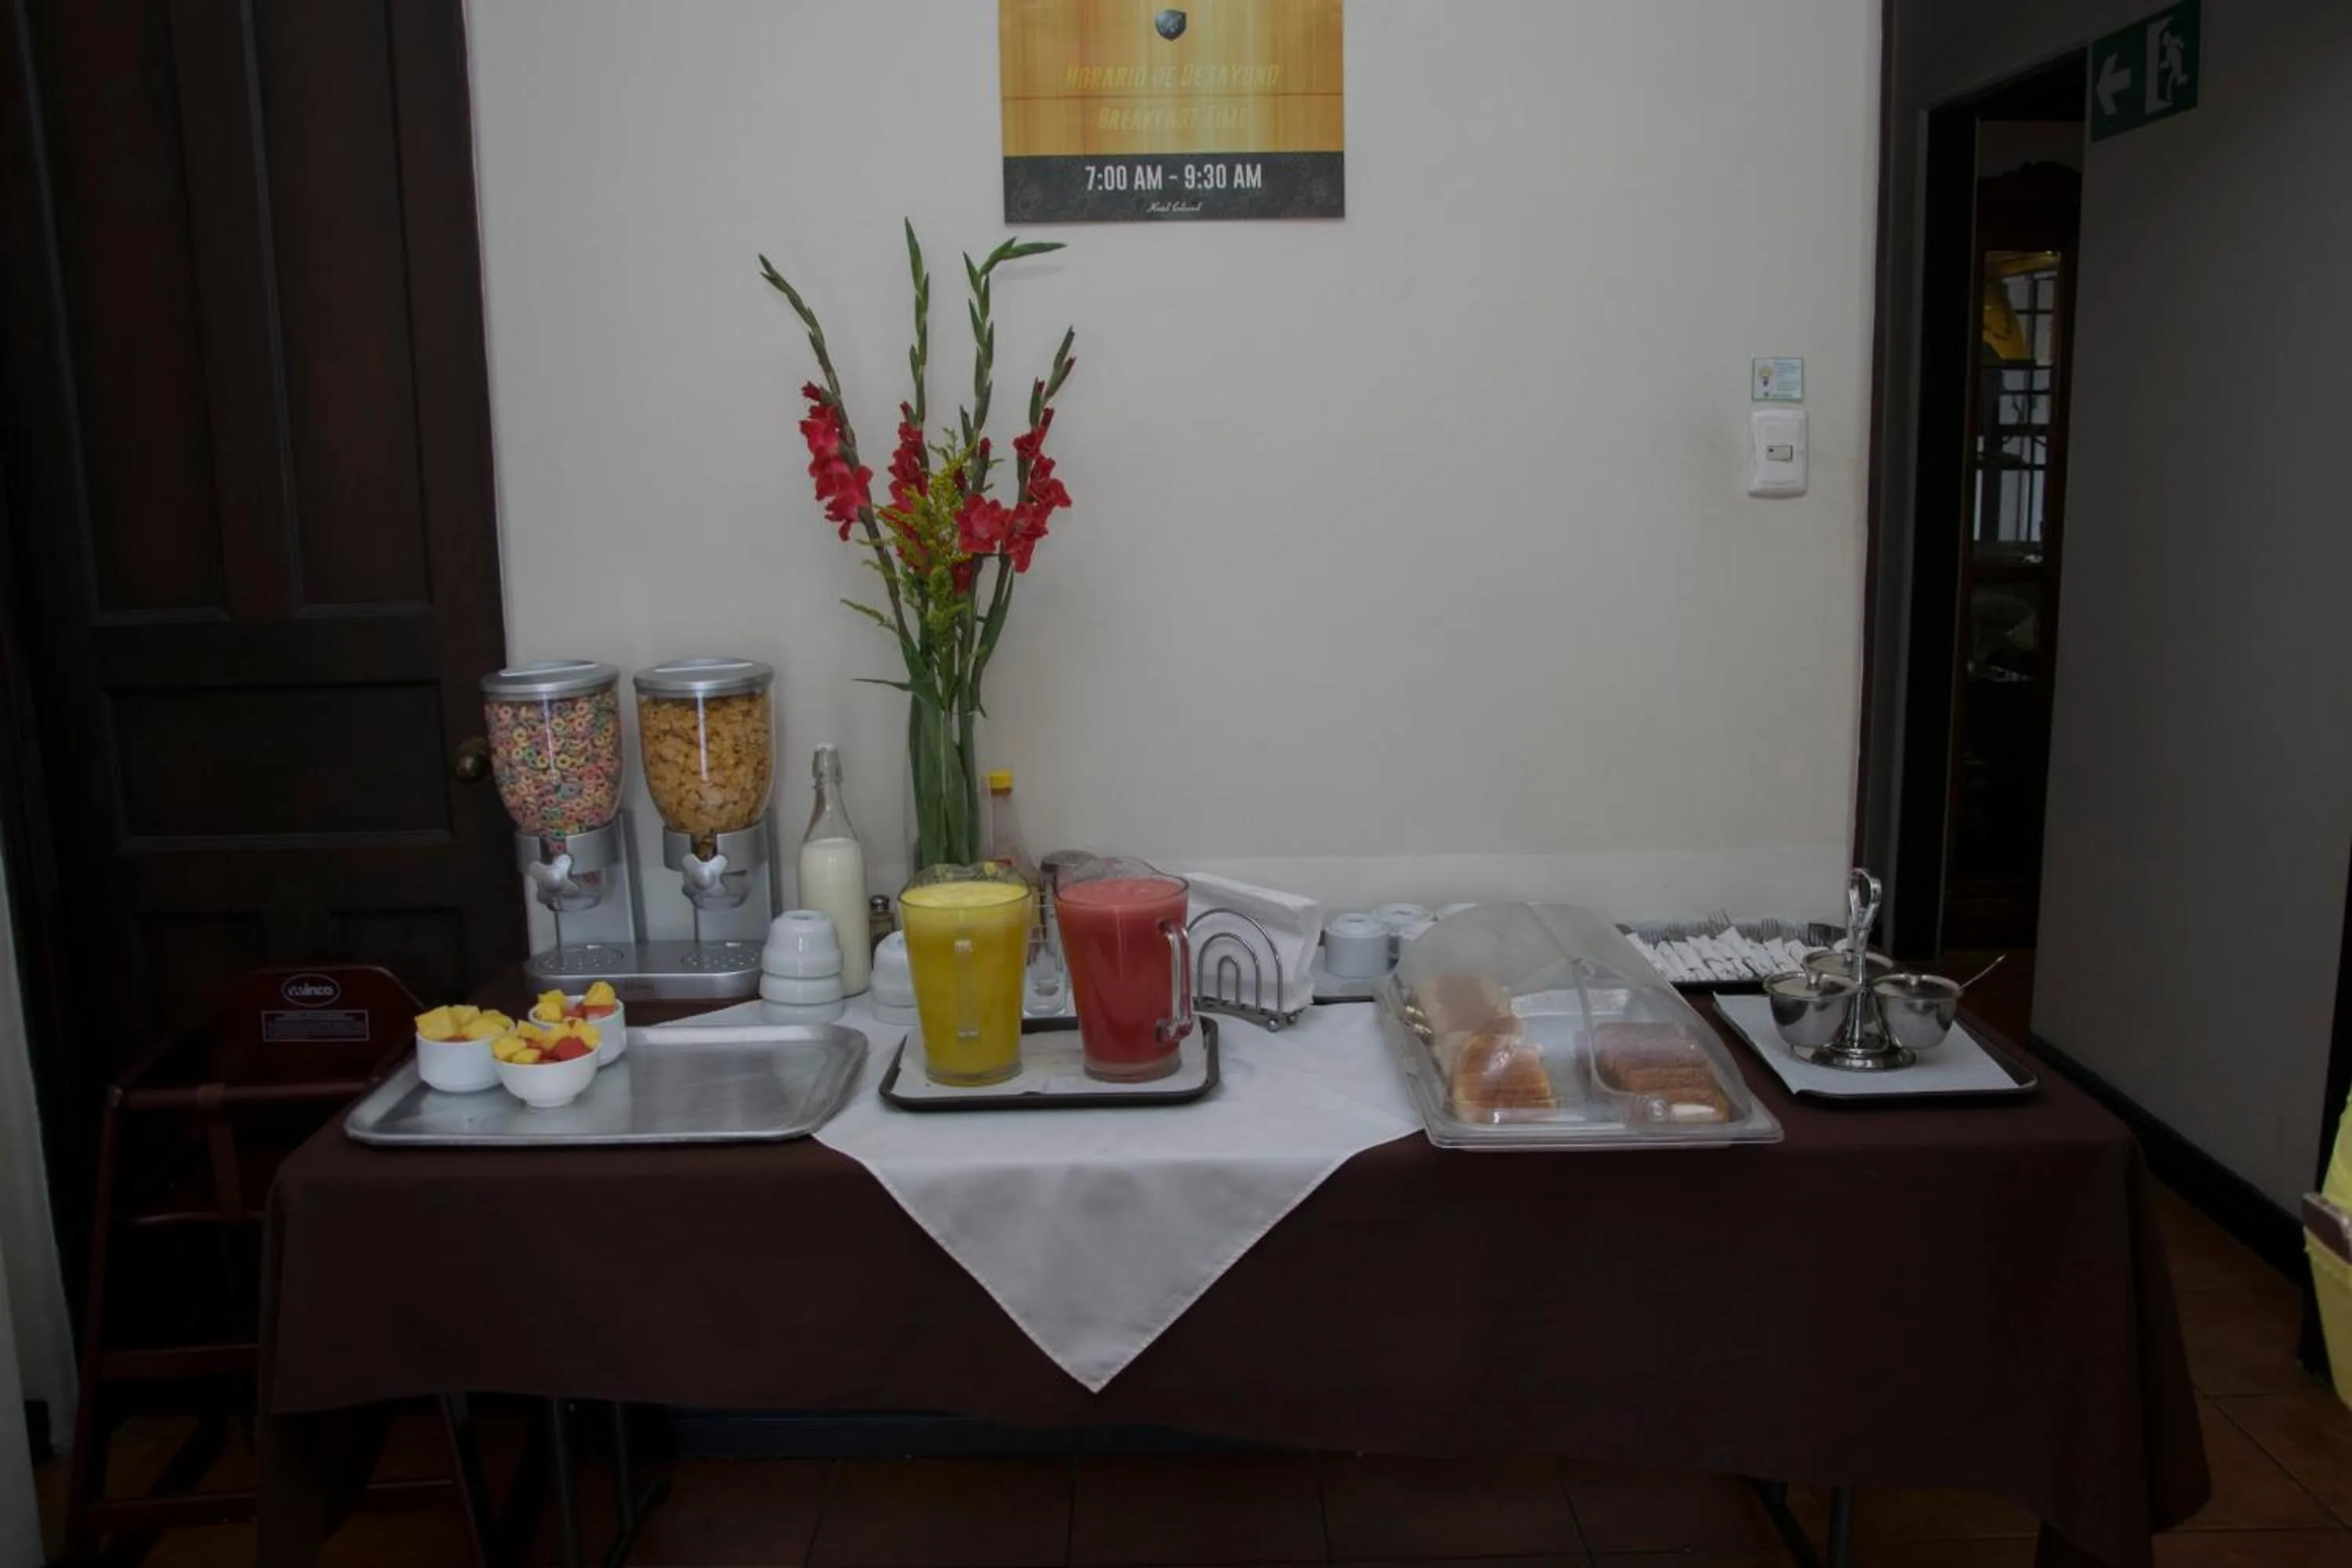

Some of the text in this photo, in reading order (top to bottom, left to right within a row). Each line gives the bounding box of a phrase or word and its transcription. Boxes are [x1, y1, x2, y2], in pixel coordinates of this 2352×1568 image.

[1085, 165, 1127, 191] 7:00
[1134, 165, 1163, 190] AM
[1185, 165, 1226, 190] 9:30
[1233, 164, 1262, 189] AM
